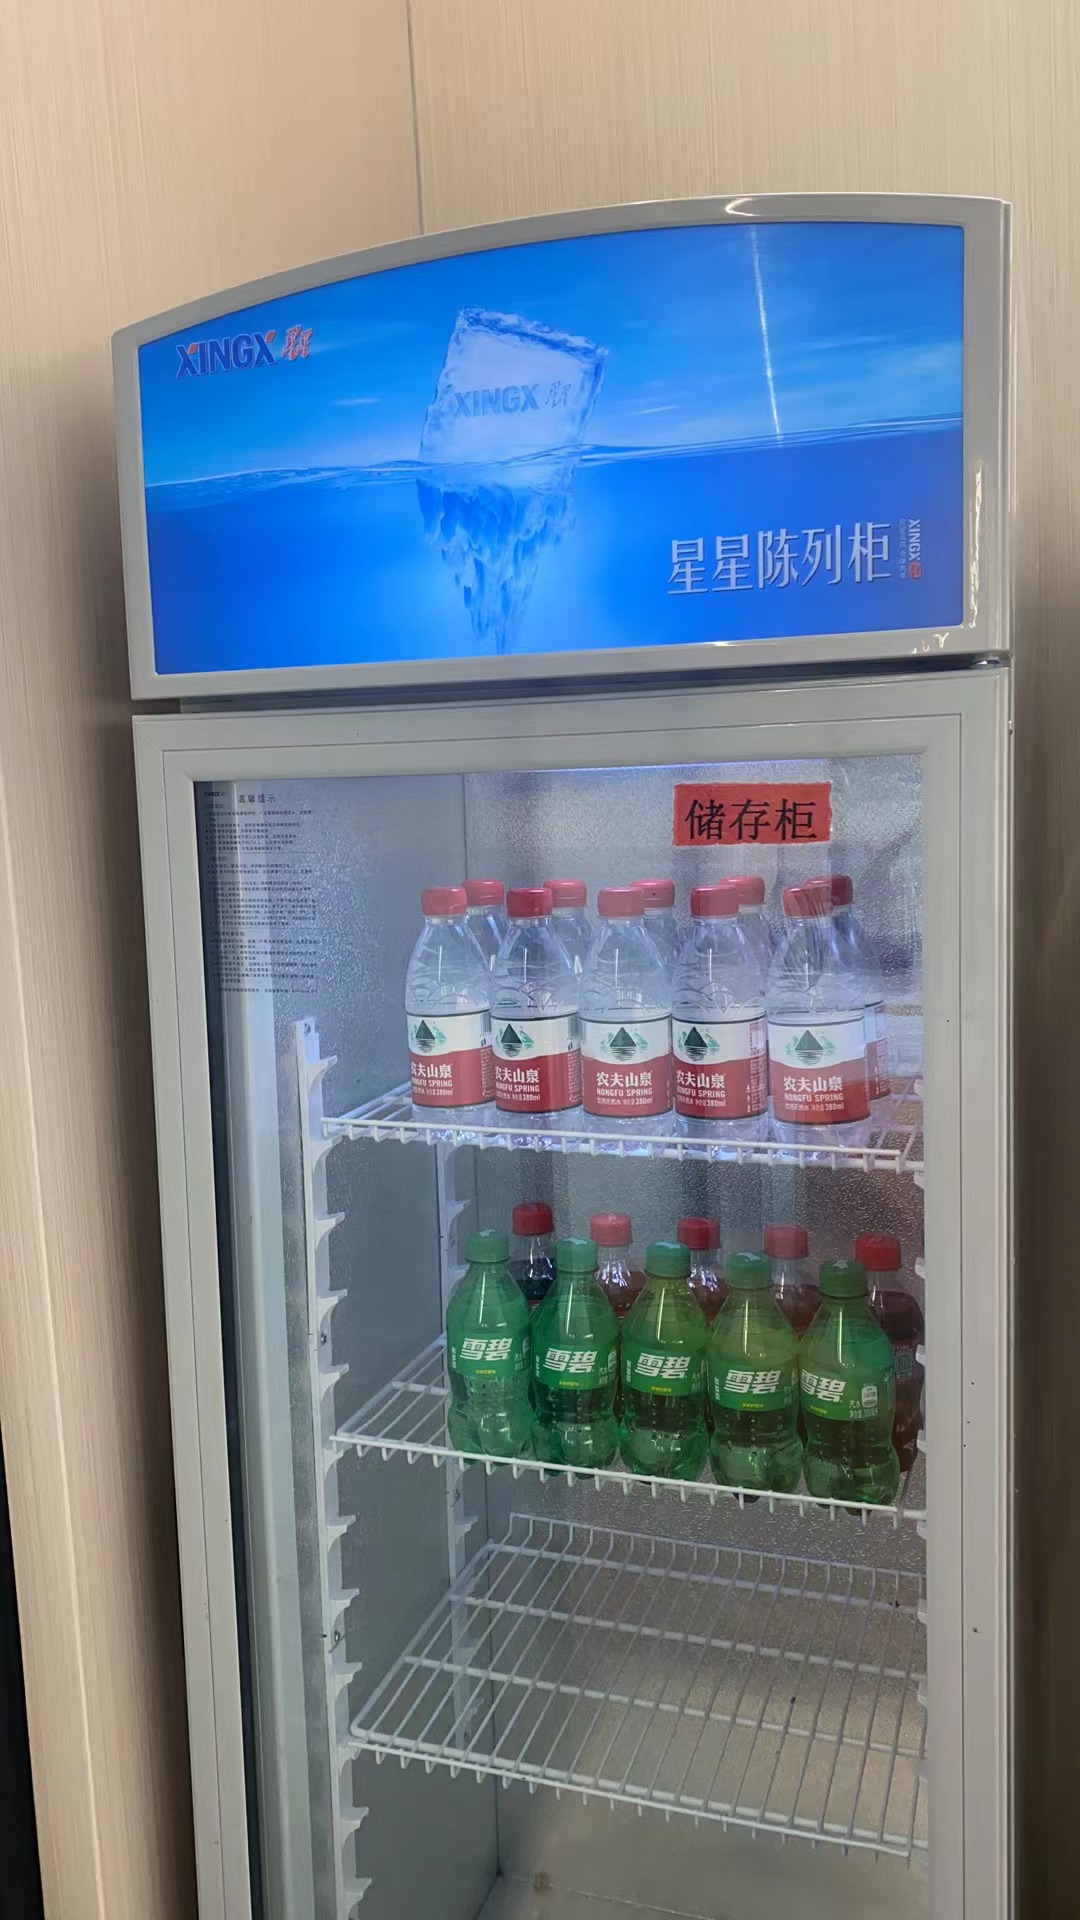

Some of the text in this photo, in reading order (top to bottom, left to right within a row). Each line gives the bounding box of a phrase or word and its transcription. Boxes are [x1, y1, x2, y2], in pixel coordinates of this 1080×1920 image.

[176, 330, 277, 378] XINGX
[454, 384, 539, 417] XINGX
[909, 519, 921, 561] XINGX
[667, 522, 892, 595] 星星陈列柜
[684, 798, 817, 841] 储存柜
[411, 1062, 452, 1078] 农夫山泉
[495, 1066, 540, 1083] 农夫山泉
[597, 1072, 652, 1087] 农夫山泉
[677, 1069, 725, 1089] 农夫山泉
[428, 1080, 453, 1088] SPRING
[514, 1084, 540, 1092] SPRING
[597, 1087, 653, 1097] NONGFU SPRING
[698, 1089, 726, 1098] SPRING
[784, 1076, 843, 1093] 农夫山泉
[785, 1092, 844, 1103] NONGFU SPRING
[460, 1337, 513, 1361] 雪碧
[543, 1348, 598, 1373] 雪碧
[635, 1352, 691, 1379] 雪碧
[724, 1370, 781, 1395] 雪碧
[800, 1369, 846, 1403] 雪碧
